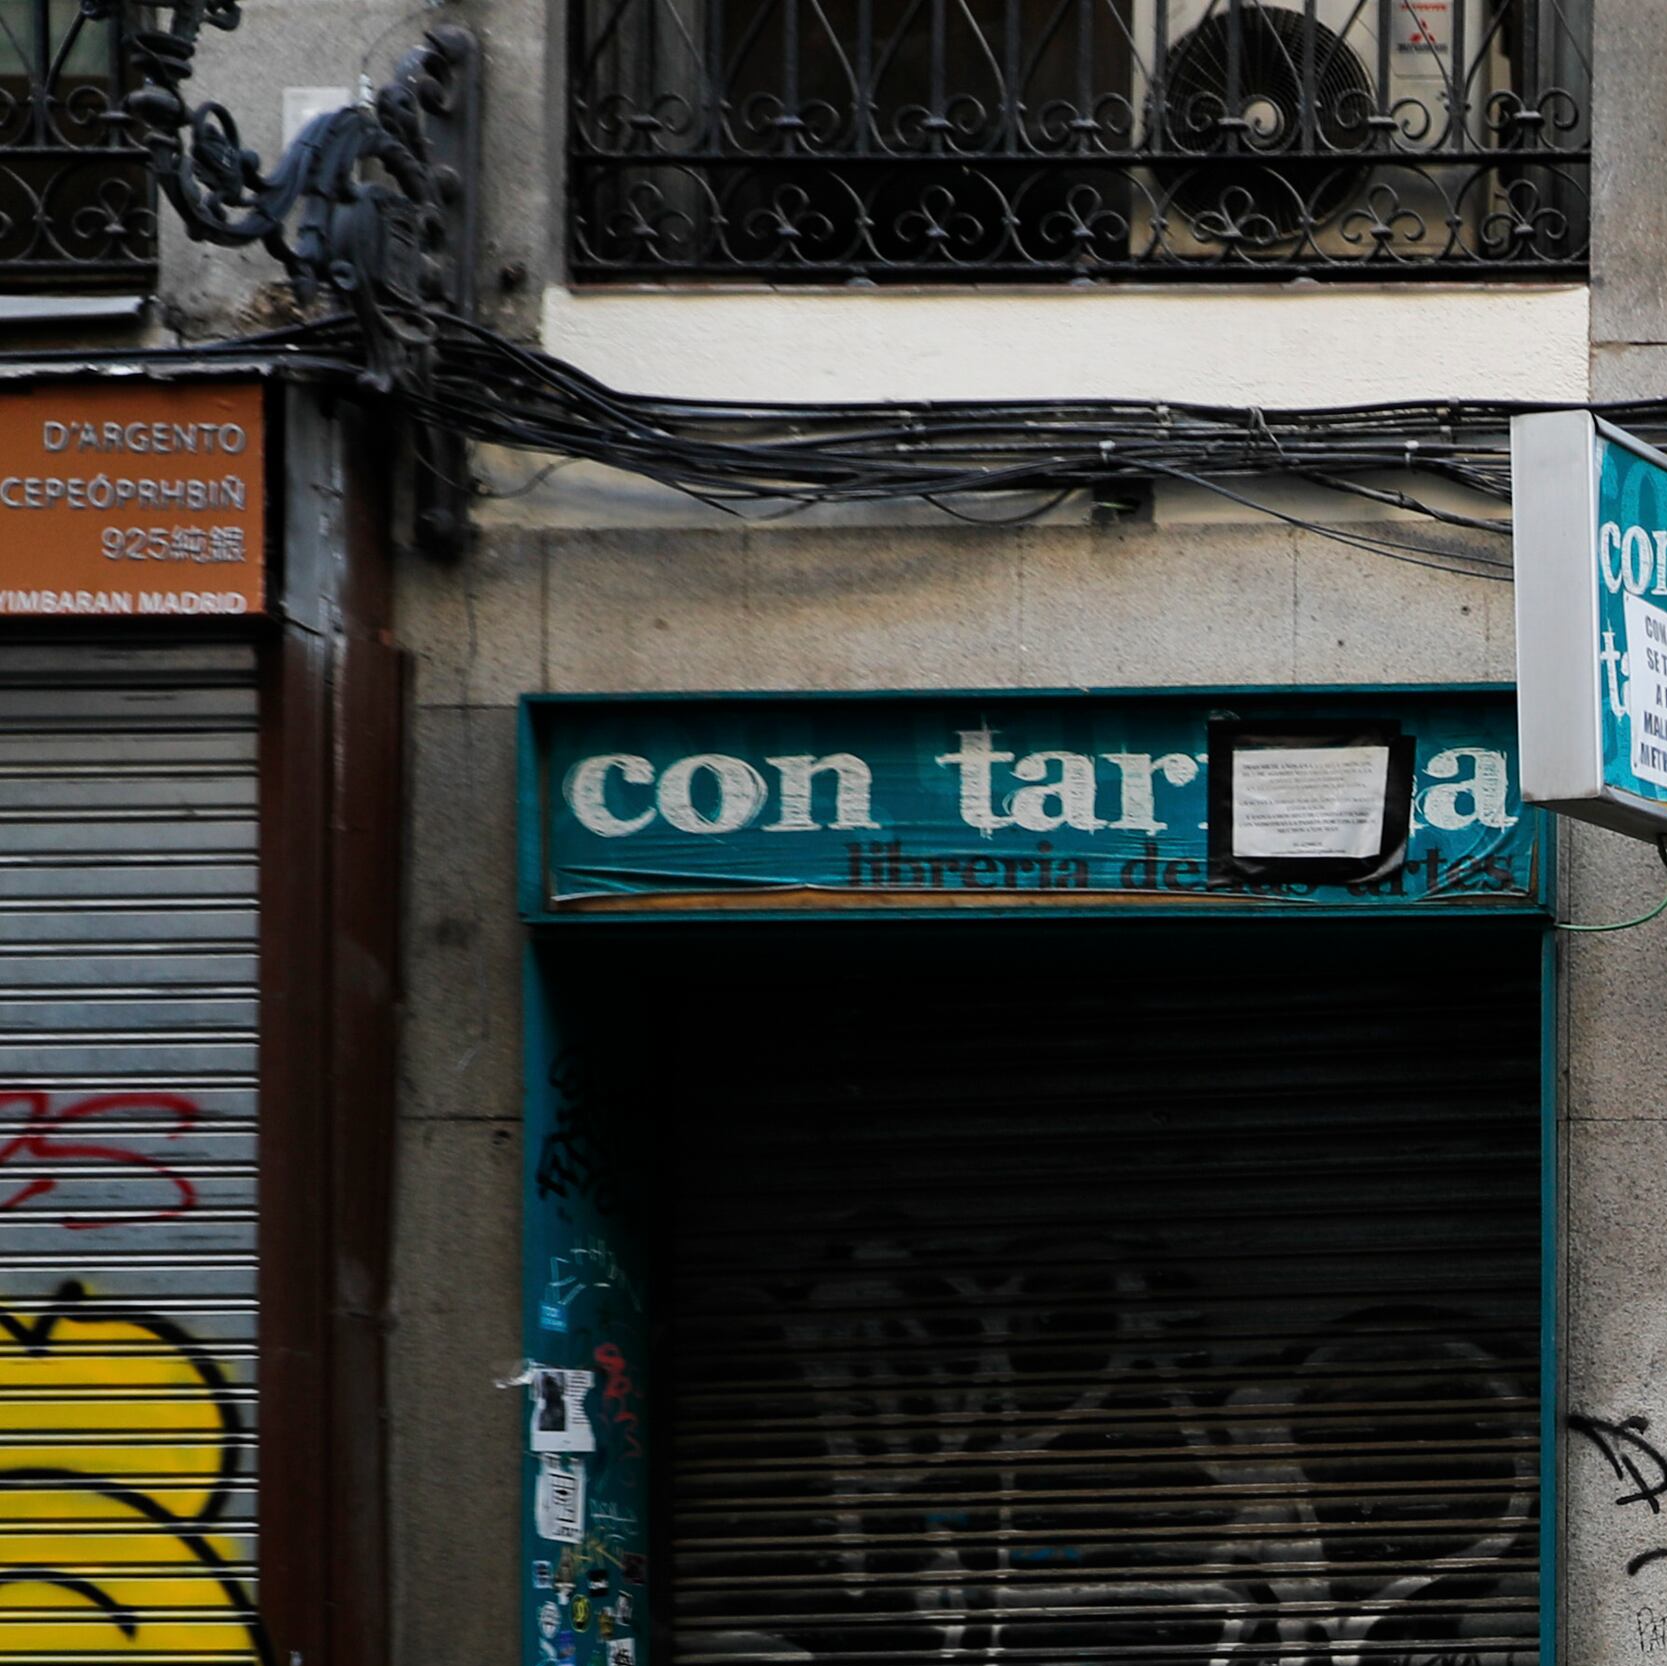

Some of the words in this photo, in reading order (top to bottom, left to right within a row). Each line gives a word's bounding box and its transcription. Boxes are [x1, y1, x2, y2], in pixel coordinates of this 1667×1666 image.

[43, 421, 246, 453] D'ARGENTO
[139, 591, 247, 615] MADRID
[1645, 615, 1667, 645] CON
[1646, 647, 1661, 674] SE
[1655, 684, 1664, 706] A
[563, 752, 881, 838] con
[934, 718, 1519, 840] tara
